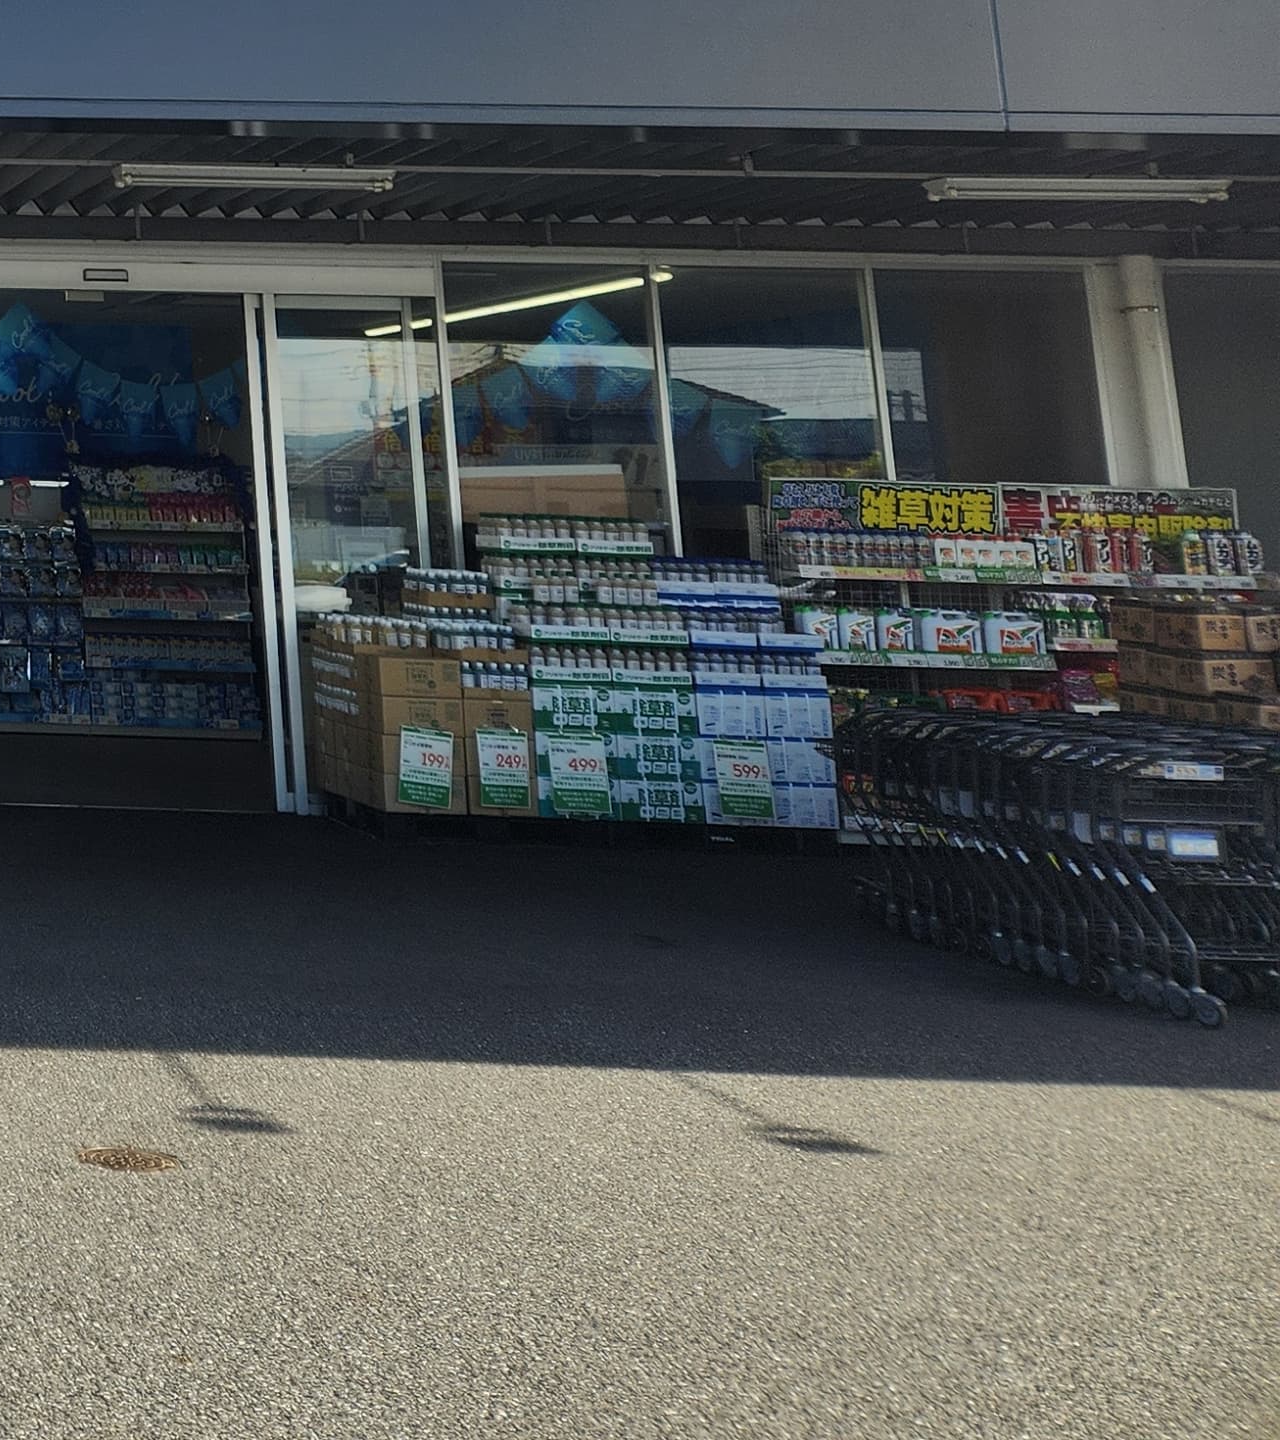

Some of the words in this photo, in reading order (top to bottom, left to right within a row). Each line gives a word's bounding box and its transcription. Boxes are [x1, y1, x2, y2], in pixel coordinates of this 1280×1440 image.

[861, 486, 994, 533] 雑草対策
[421, 752, 445, 767] 199
[495, 753, 522, 769] 249
[568, 758, 598, 772] 499
[732, 763, 761, 779] 599
